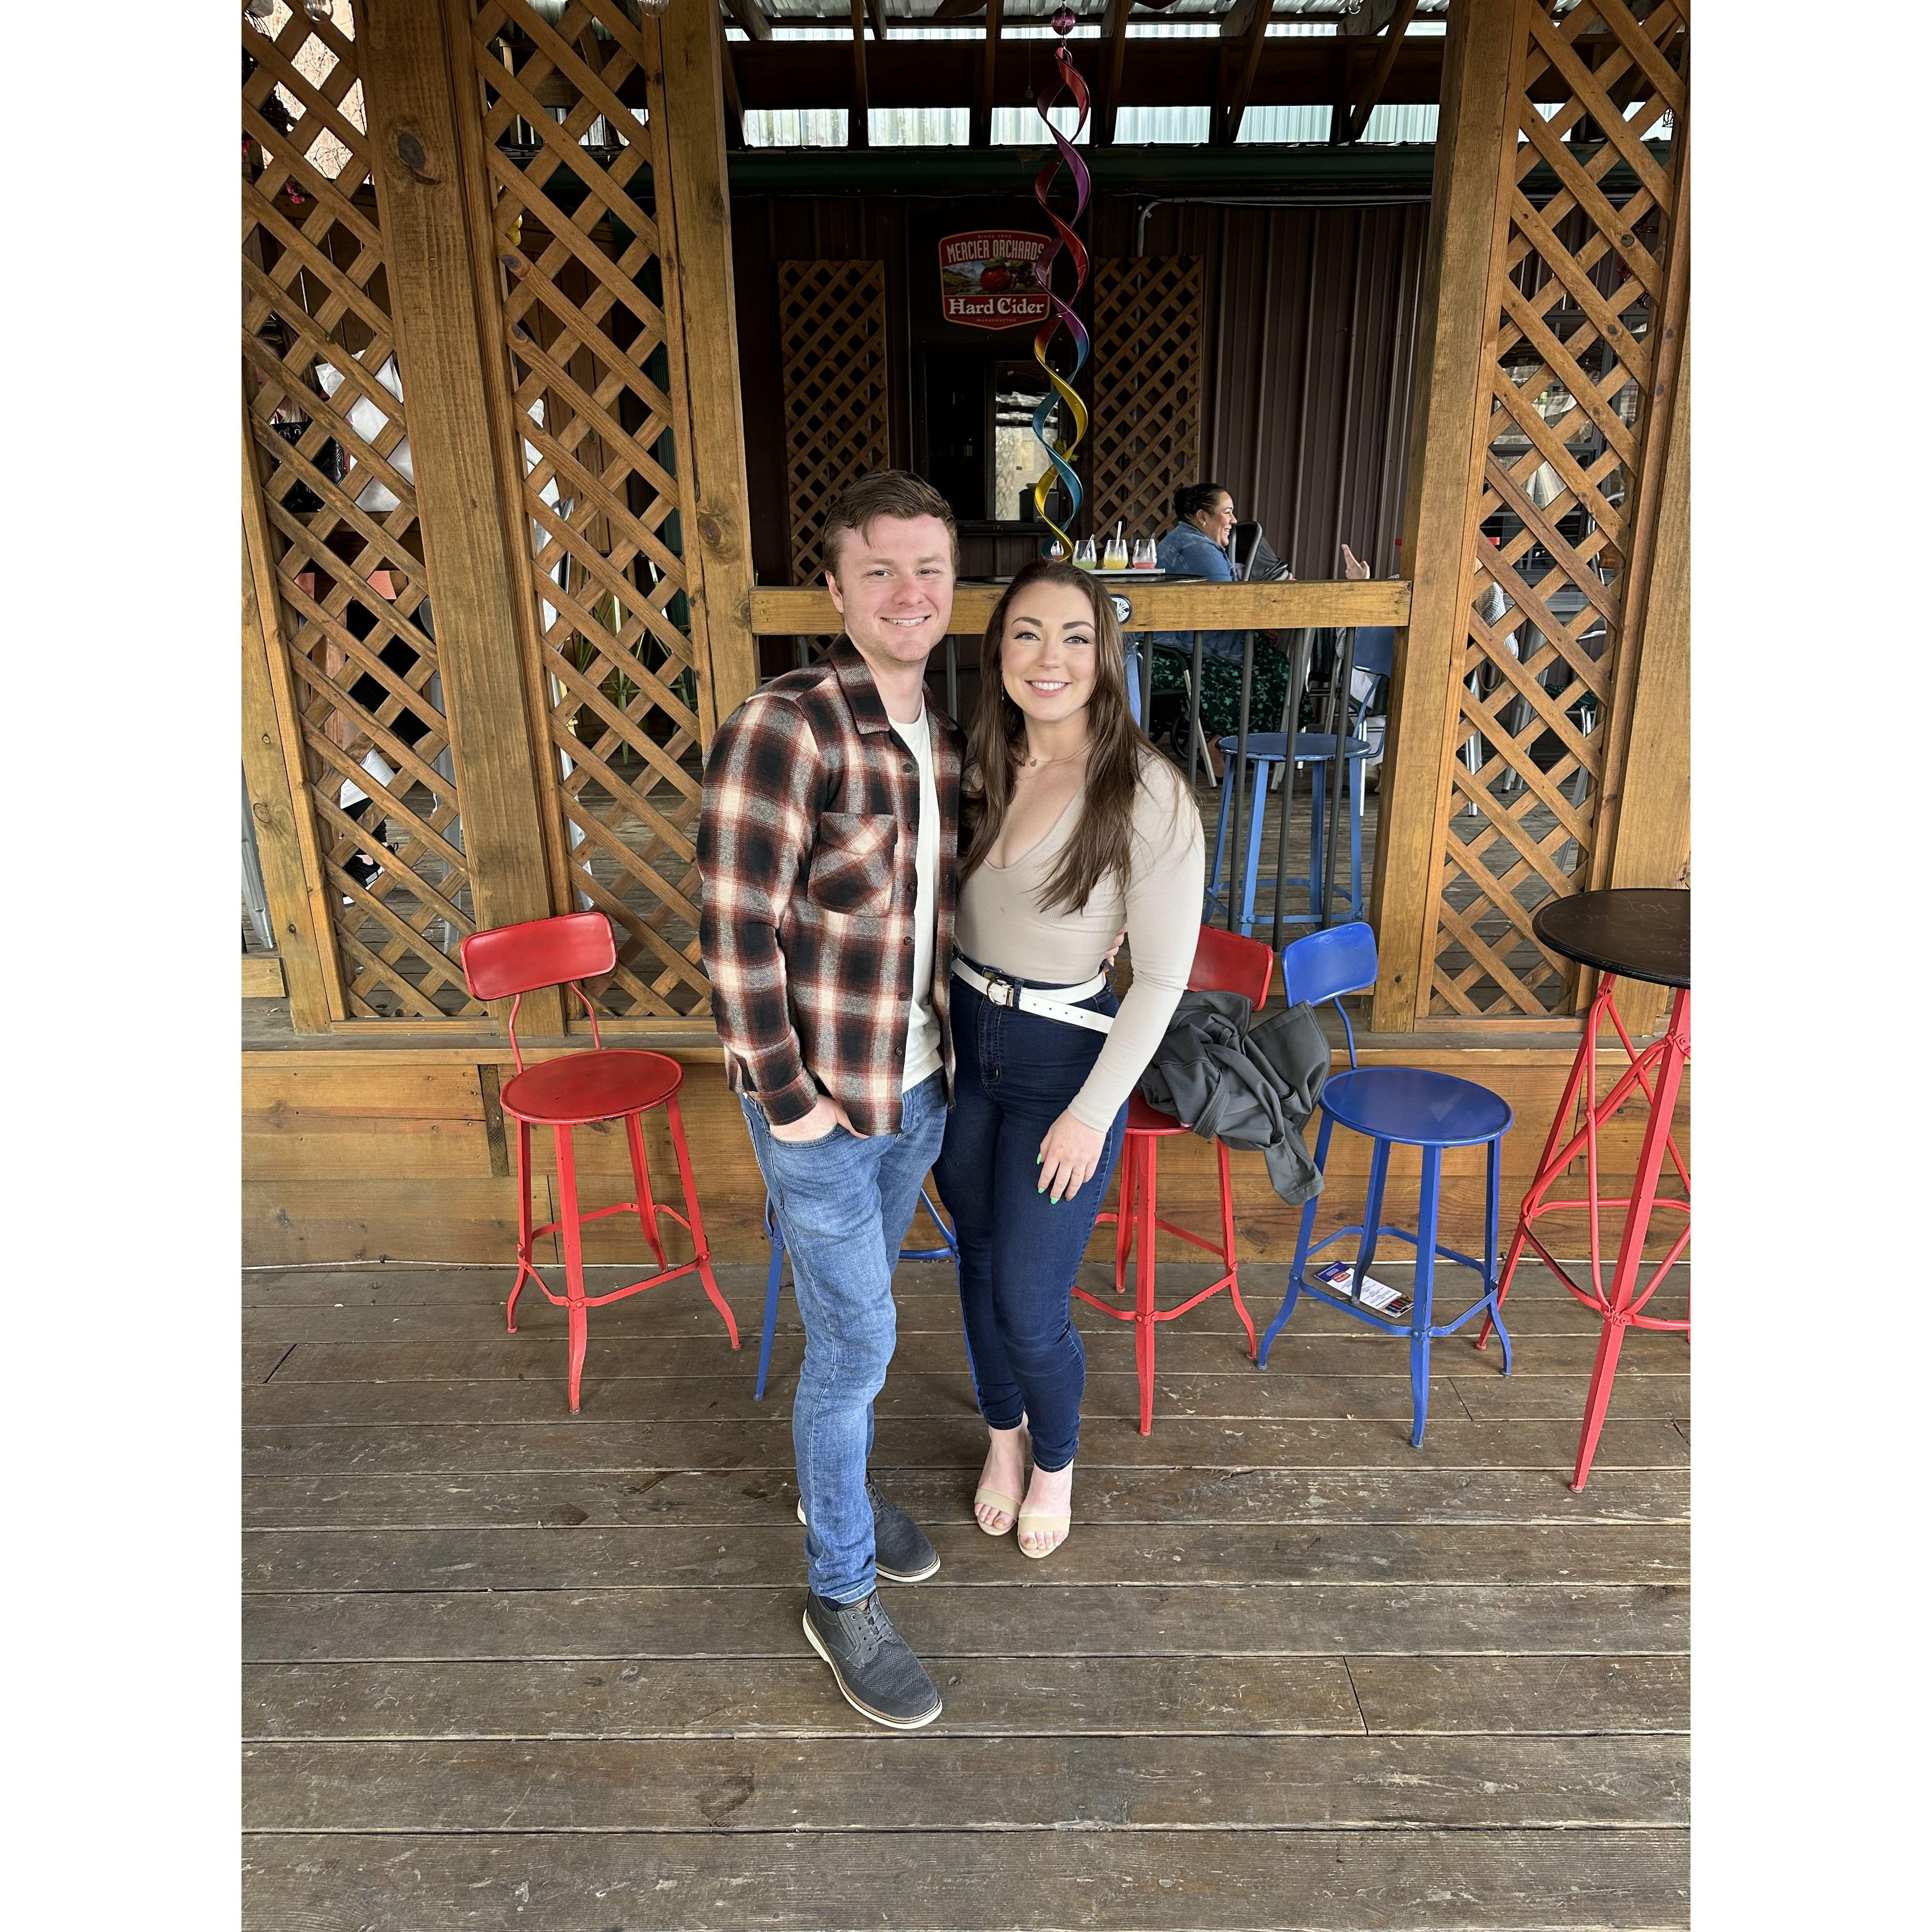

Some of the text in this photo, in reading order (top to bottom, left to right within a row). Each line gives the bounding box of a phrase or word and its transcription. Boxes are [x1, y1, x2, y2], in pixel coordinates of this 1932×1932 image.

[946, 240, 989, 263] MERCIER
[948, 298, 1045, 314] Hard Cider
